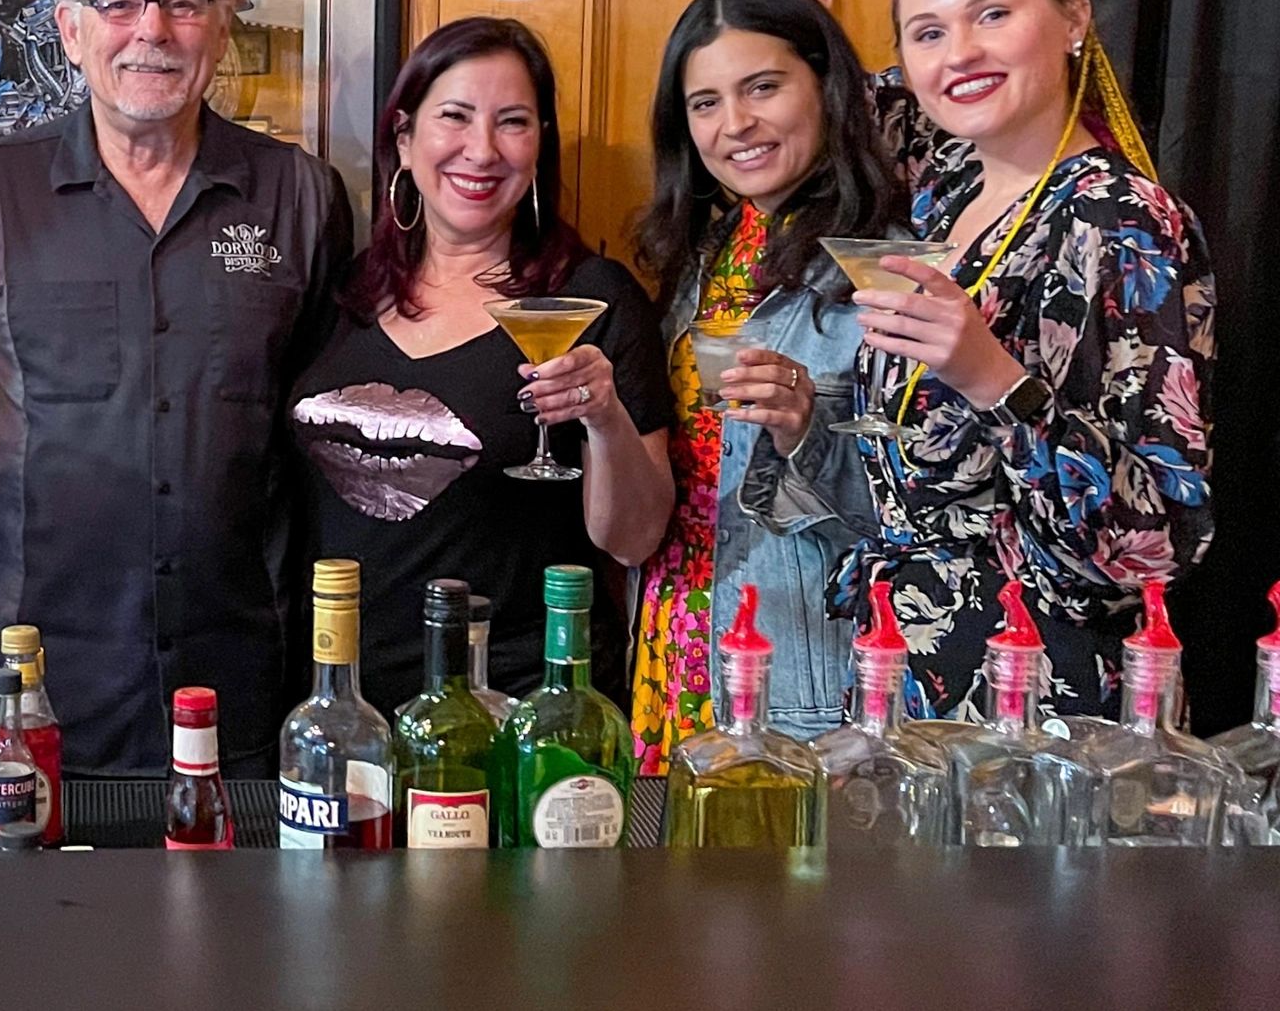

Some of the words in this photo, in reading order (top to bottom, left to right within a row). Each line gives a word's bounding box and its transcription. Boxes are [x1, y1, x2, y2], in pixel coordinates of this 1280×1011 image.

[211, 240, 279, 260] DORWOD
[430, 809, 470, 820] GALLO
[428, 830, 472, 839] VERMOUTH
